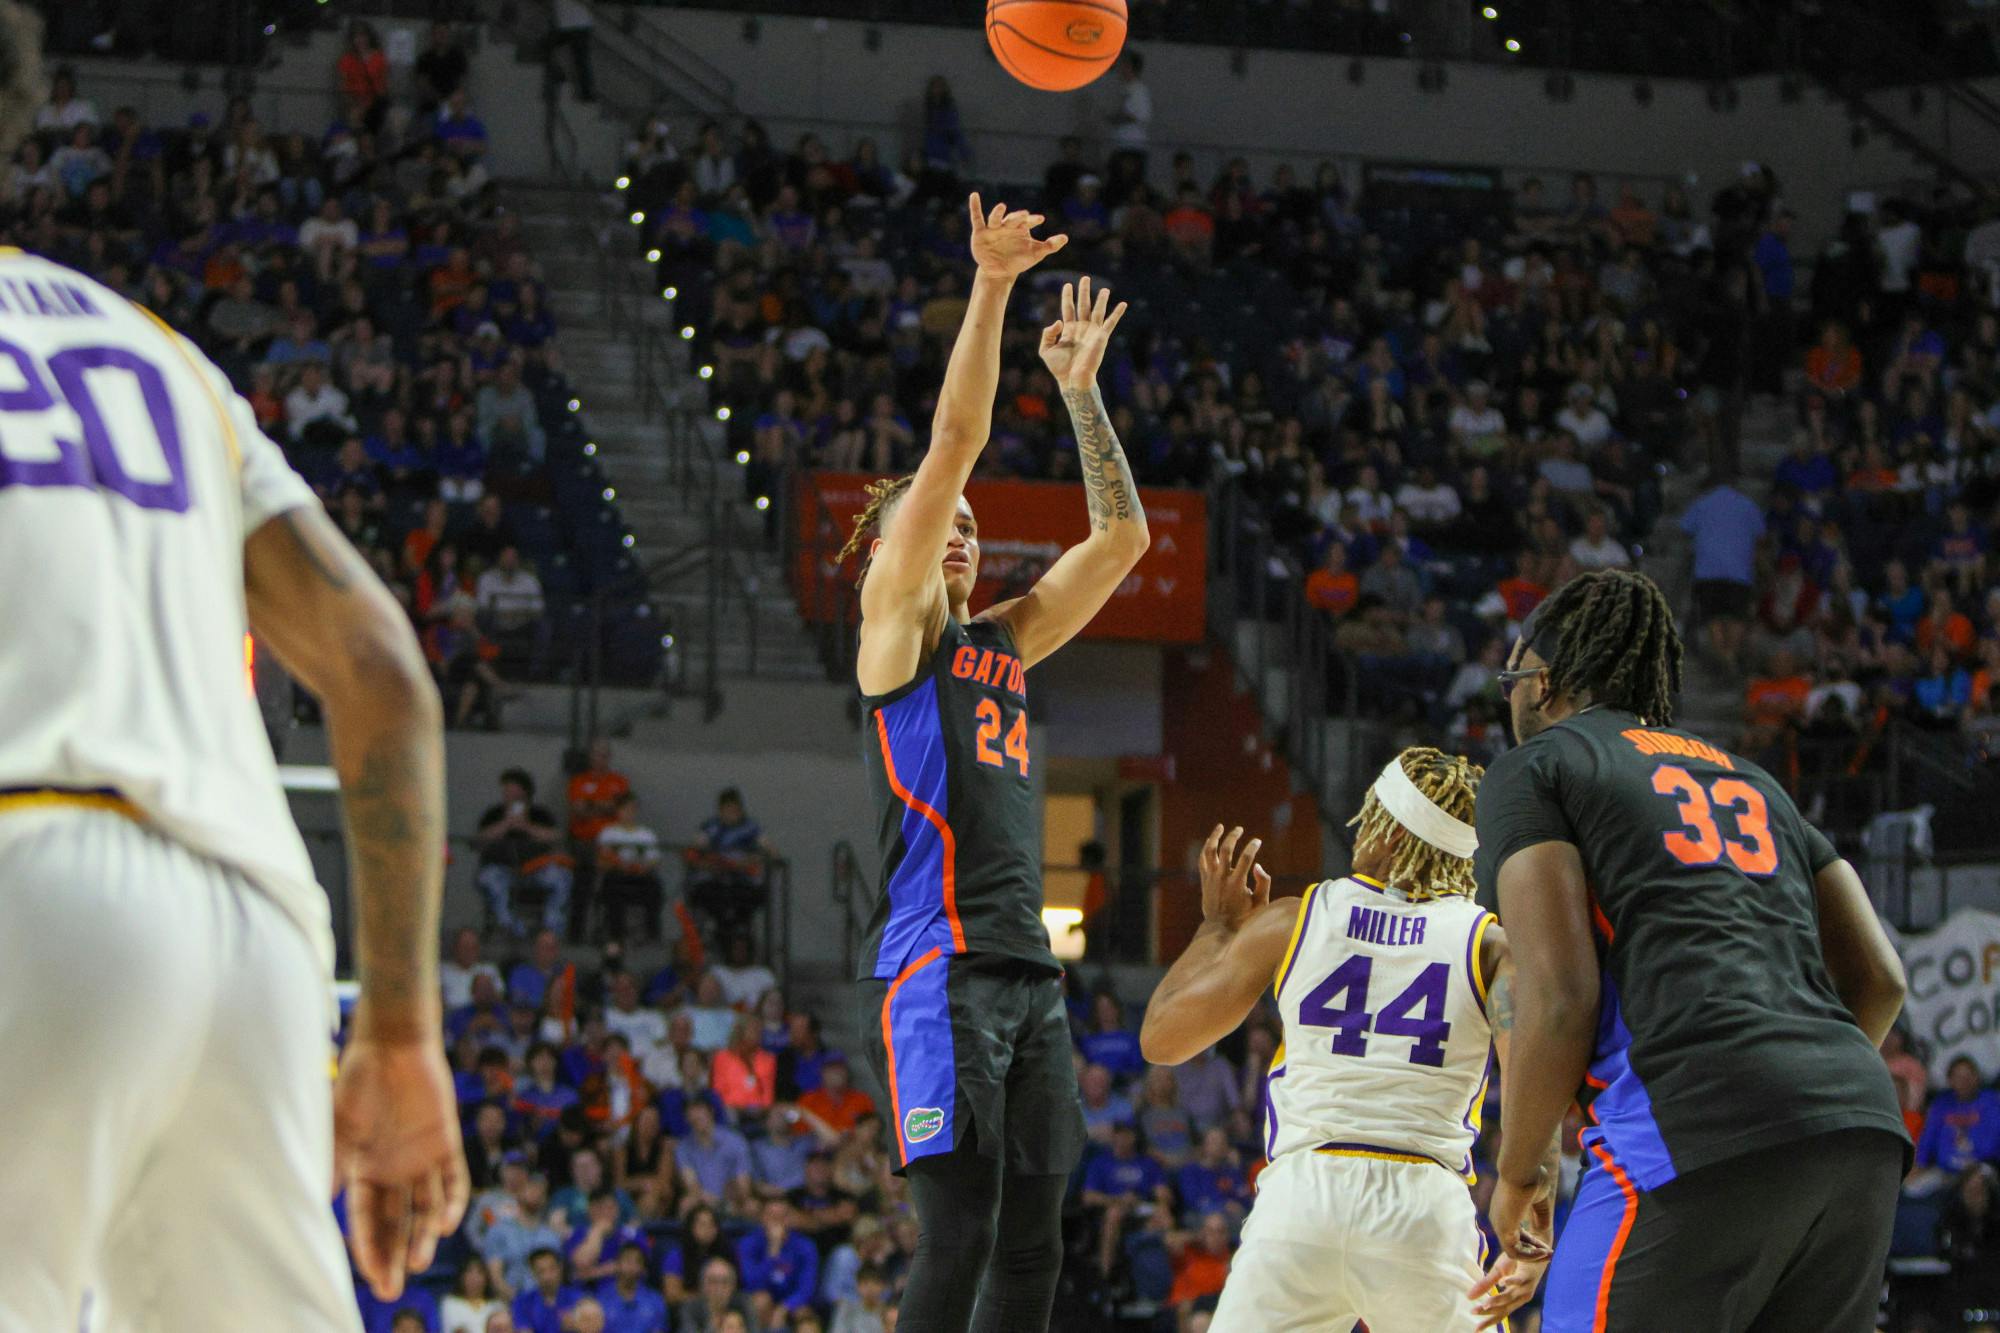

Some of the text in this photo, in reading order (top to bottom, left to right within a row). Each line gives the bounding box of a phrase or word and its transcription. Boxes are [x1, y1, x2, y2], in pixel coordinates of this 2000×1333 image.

[1110, 479, 1129, 521] 2003
[975, 697, 1029, 777] 24
[1651, 764, 1779, 875] 33
[1347, 905, 1427, 946] MILLER
[1299, 954, 1451, 1068] 44
[1934, 998, 2000, 1047] CO
